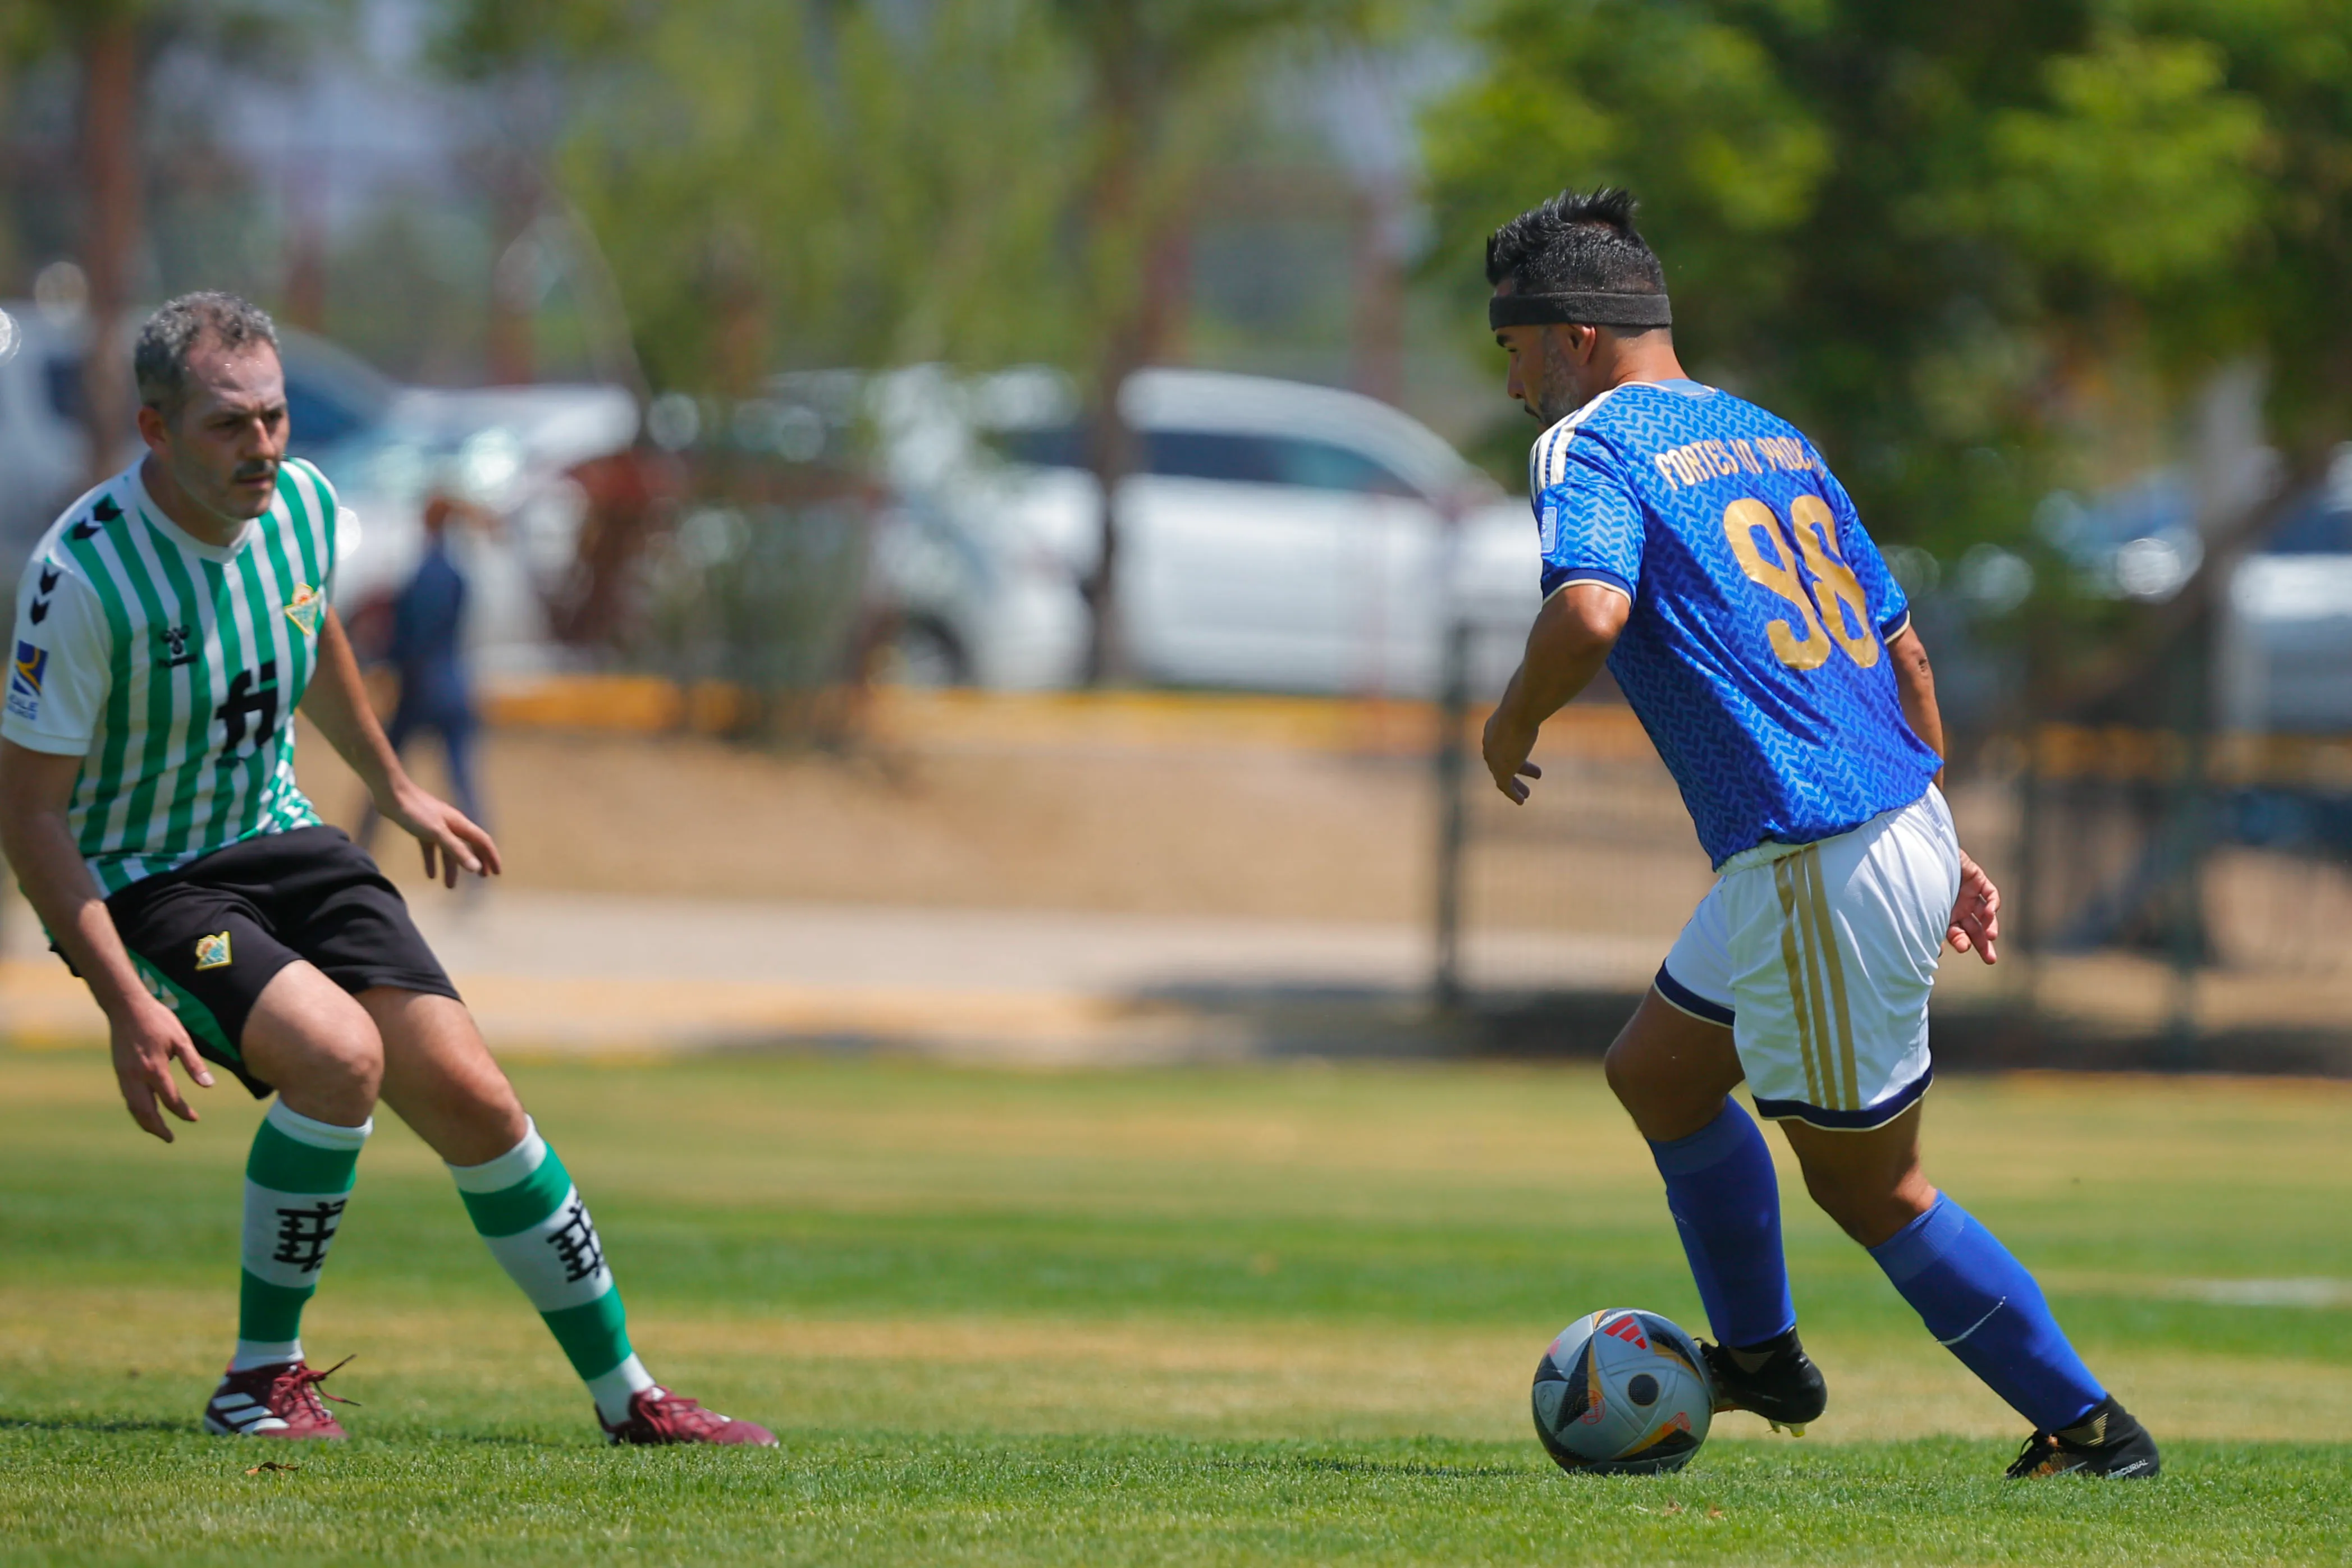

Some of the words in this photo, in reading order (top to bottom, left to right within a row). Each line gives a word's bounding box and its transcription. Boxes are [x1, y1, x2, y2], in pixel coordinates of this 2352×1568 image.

[1654, 439, 1740, 491] FORTES
[1723, 494, 1879, 671] 98
[2106, 1459, 2149, 1480] CURIAL
